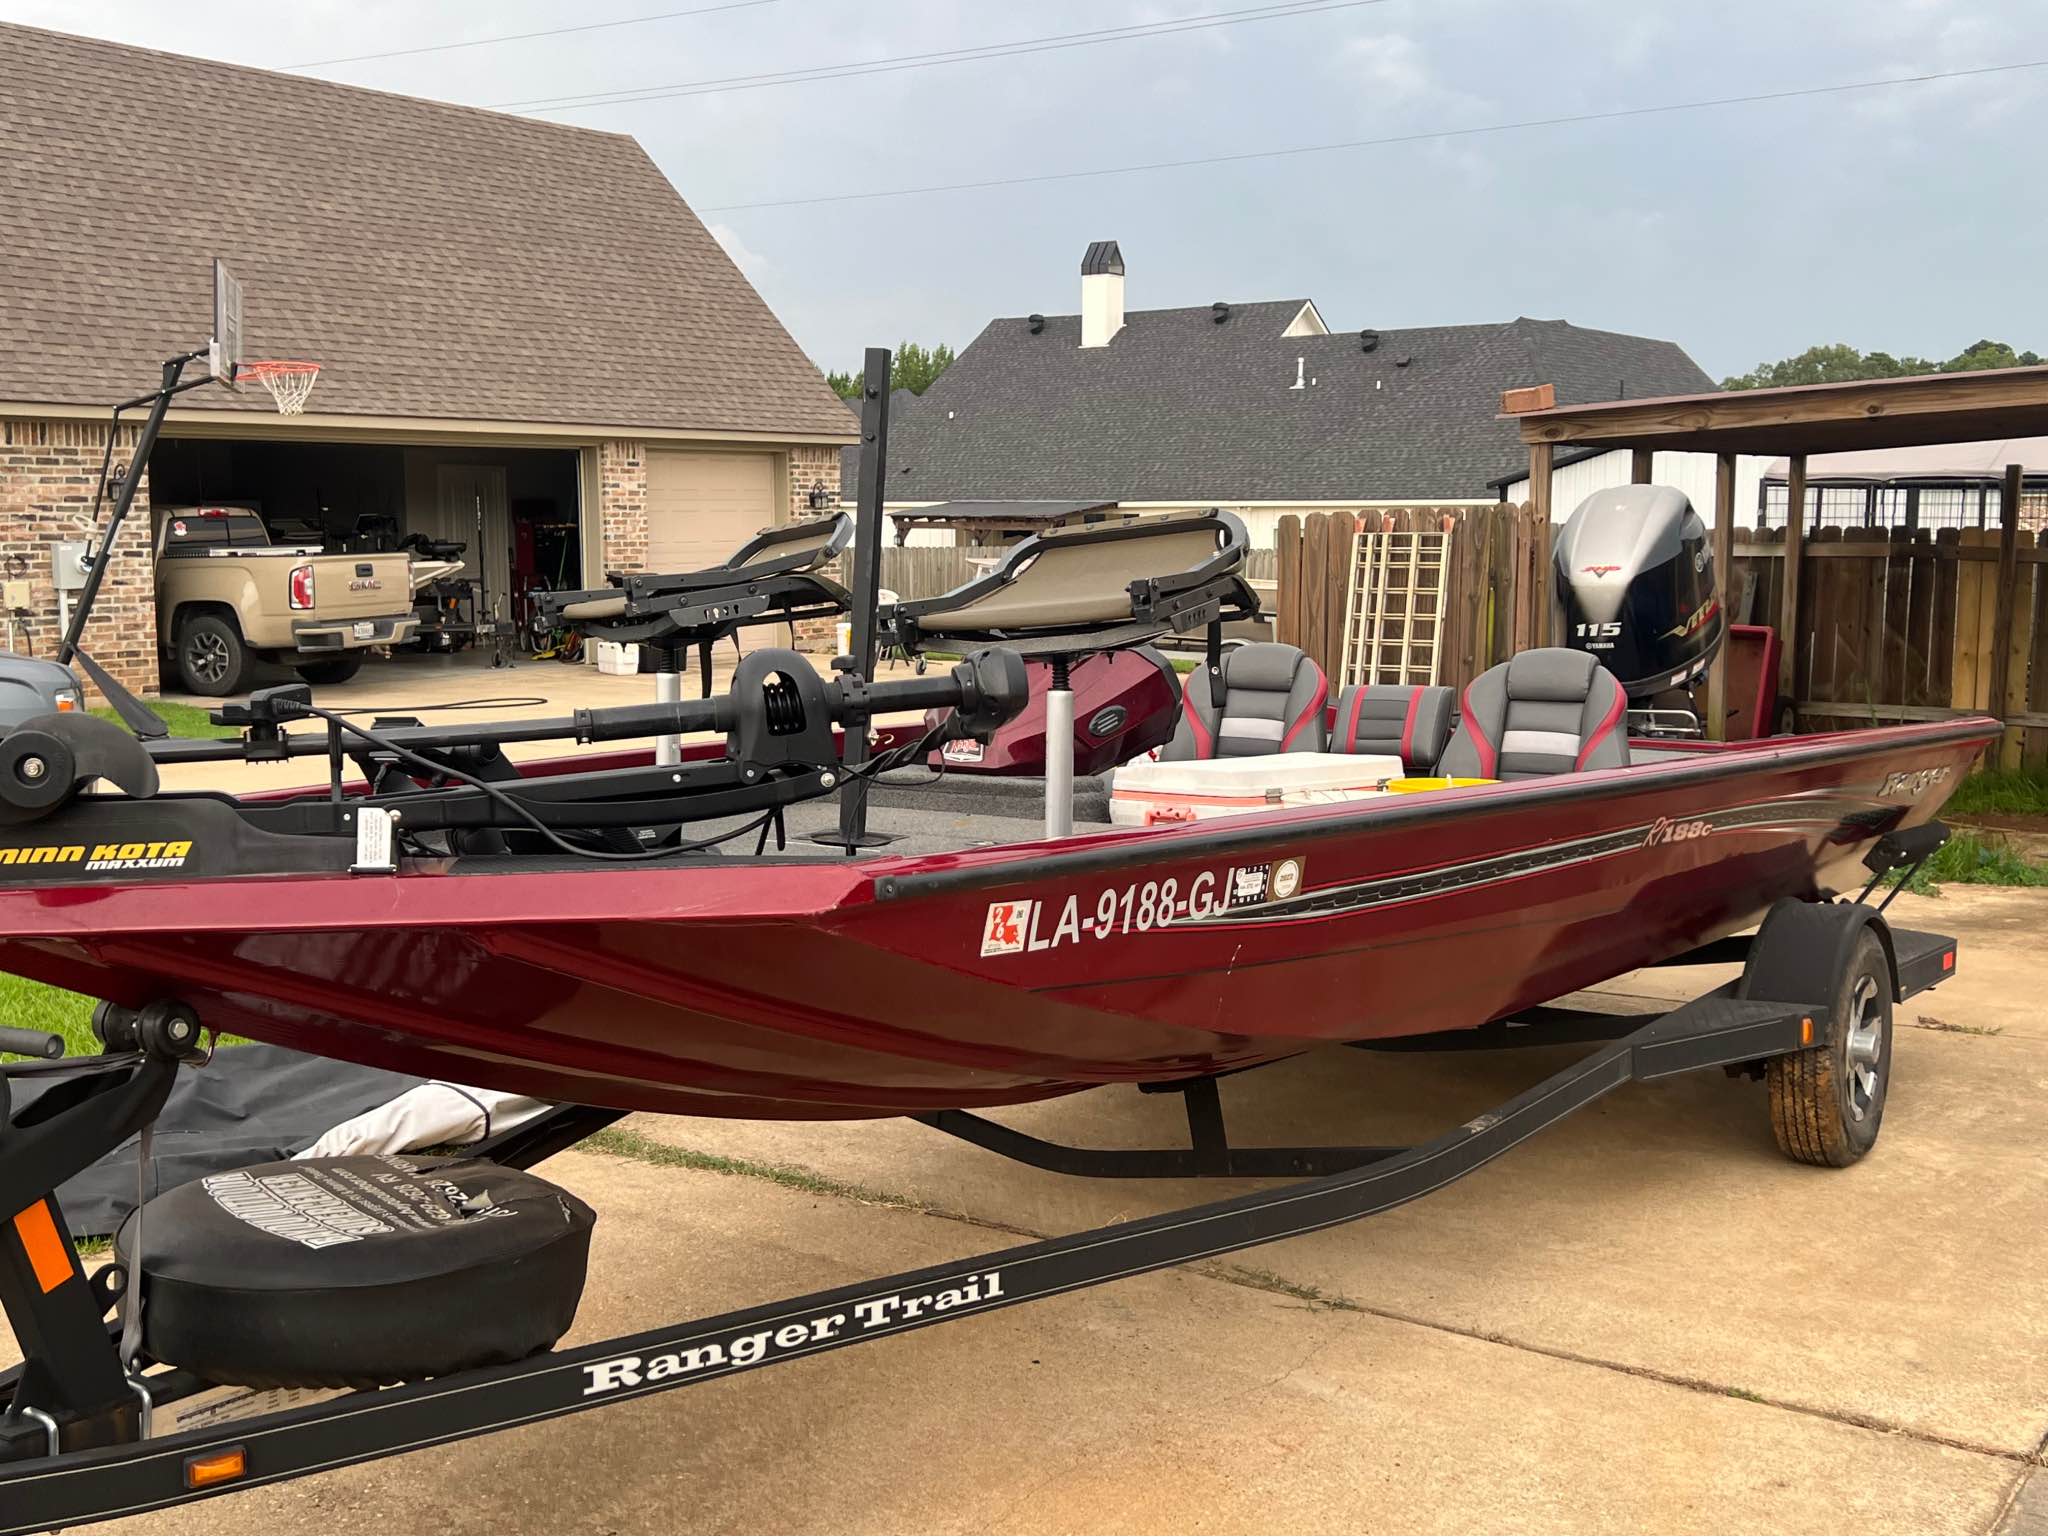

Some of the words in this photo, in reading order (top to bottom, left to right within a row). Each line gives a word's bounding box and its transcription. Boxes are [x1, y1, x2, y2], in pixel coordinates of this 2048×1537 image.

[1576, 622, 1622, 637] 115
[89, 841, 193, 861] KOTA
[85, 857, 186, 871] MAXXUM
[993, 906, 1004, 924] 2
[1028, 867, 1235, 952] LA-9188-GJ
[995, 921, 1005, 939] 6
[368, 1171, 402, 1183] RV
[255, 1172, 394, 1236] SUPERCENTER
[583, 1313, 845, 1395] Ranger
[854, 1271, 1004, 1329] Trail
